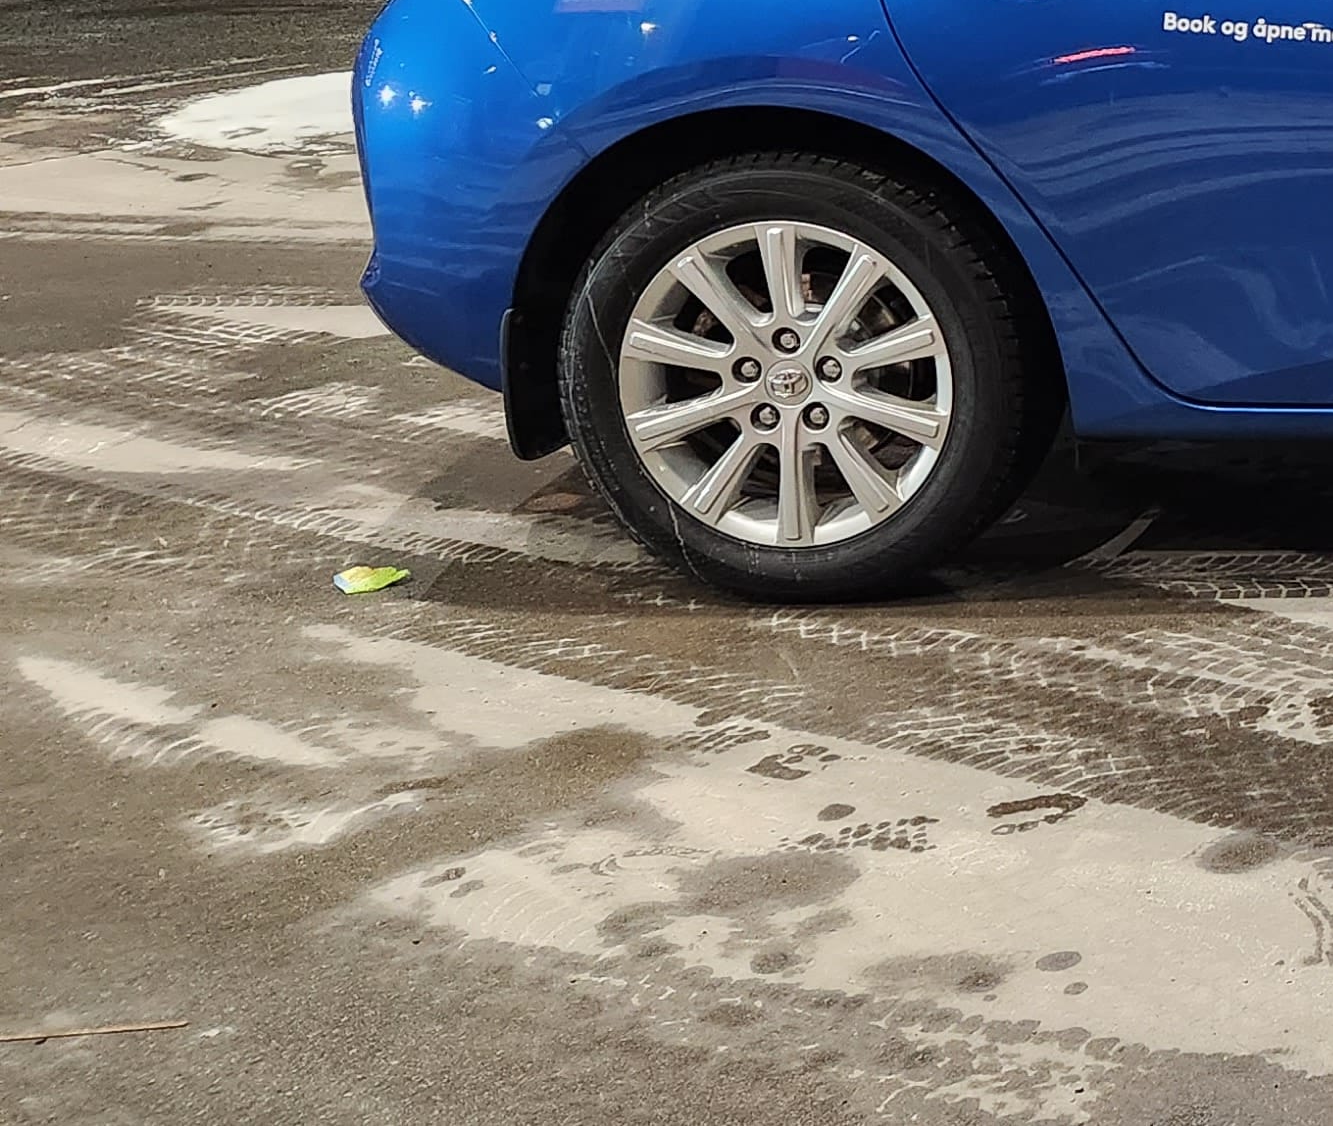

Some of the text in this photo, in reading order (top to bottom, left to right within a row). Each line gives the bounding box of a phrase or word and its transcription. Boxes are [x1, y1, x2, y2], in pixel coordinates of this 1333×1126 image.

[1162, 12, 1217, 34] Book
[1220, 20, 1249, 42] og
[1252, 18, 1307, 44] åpne
